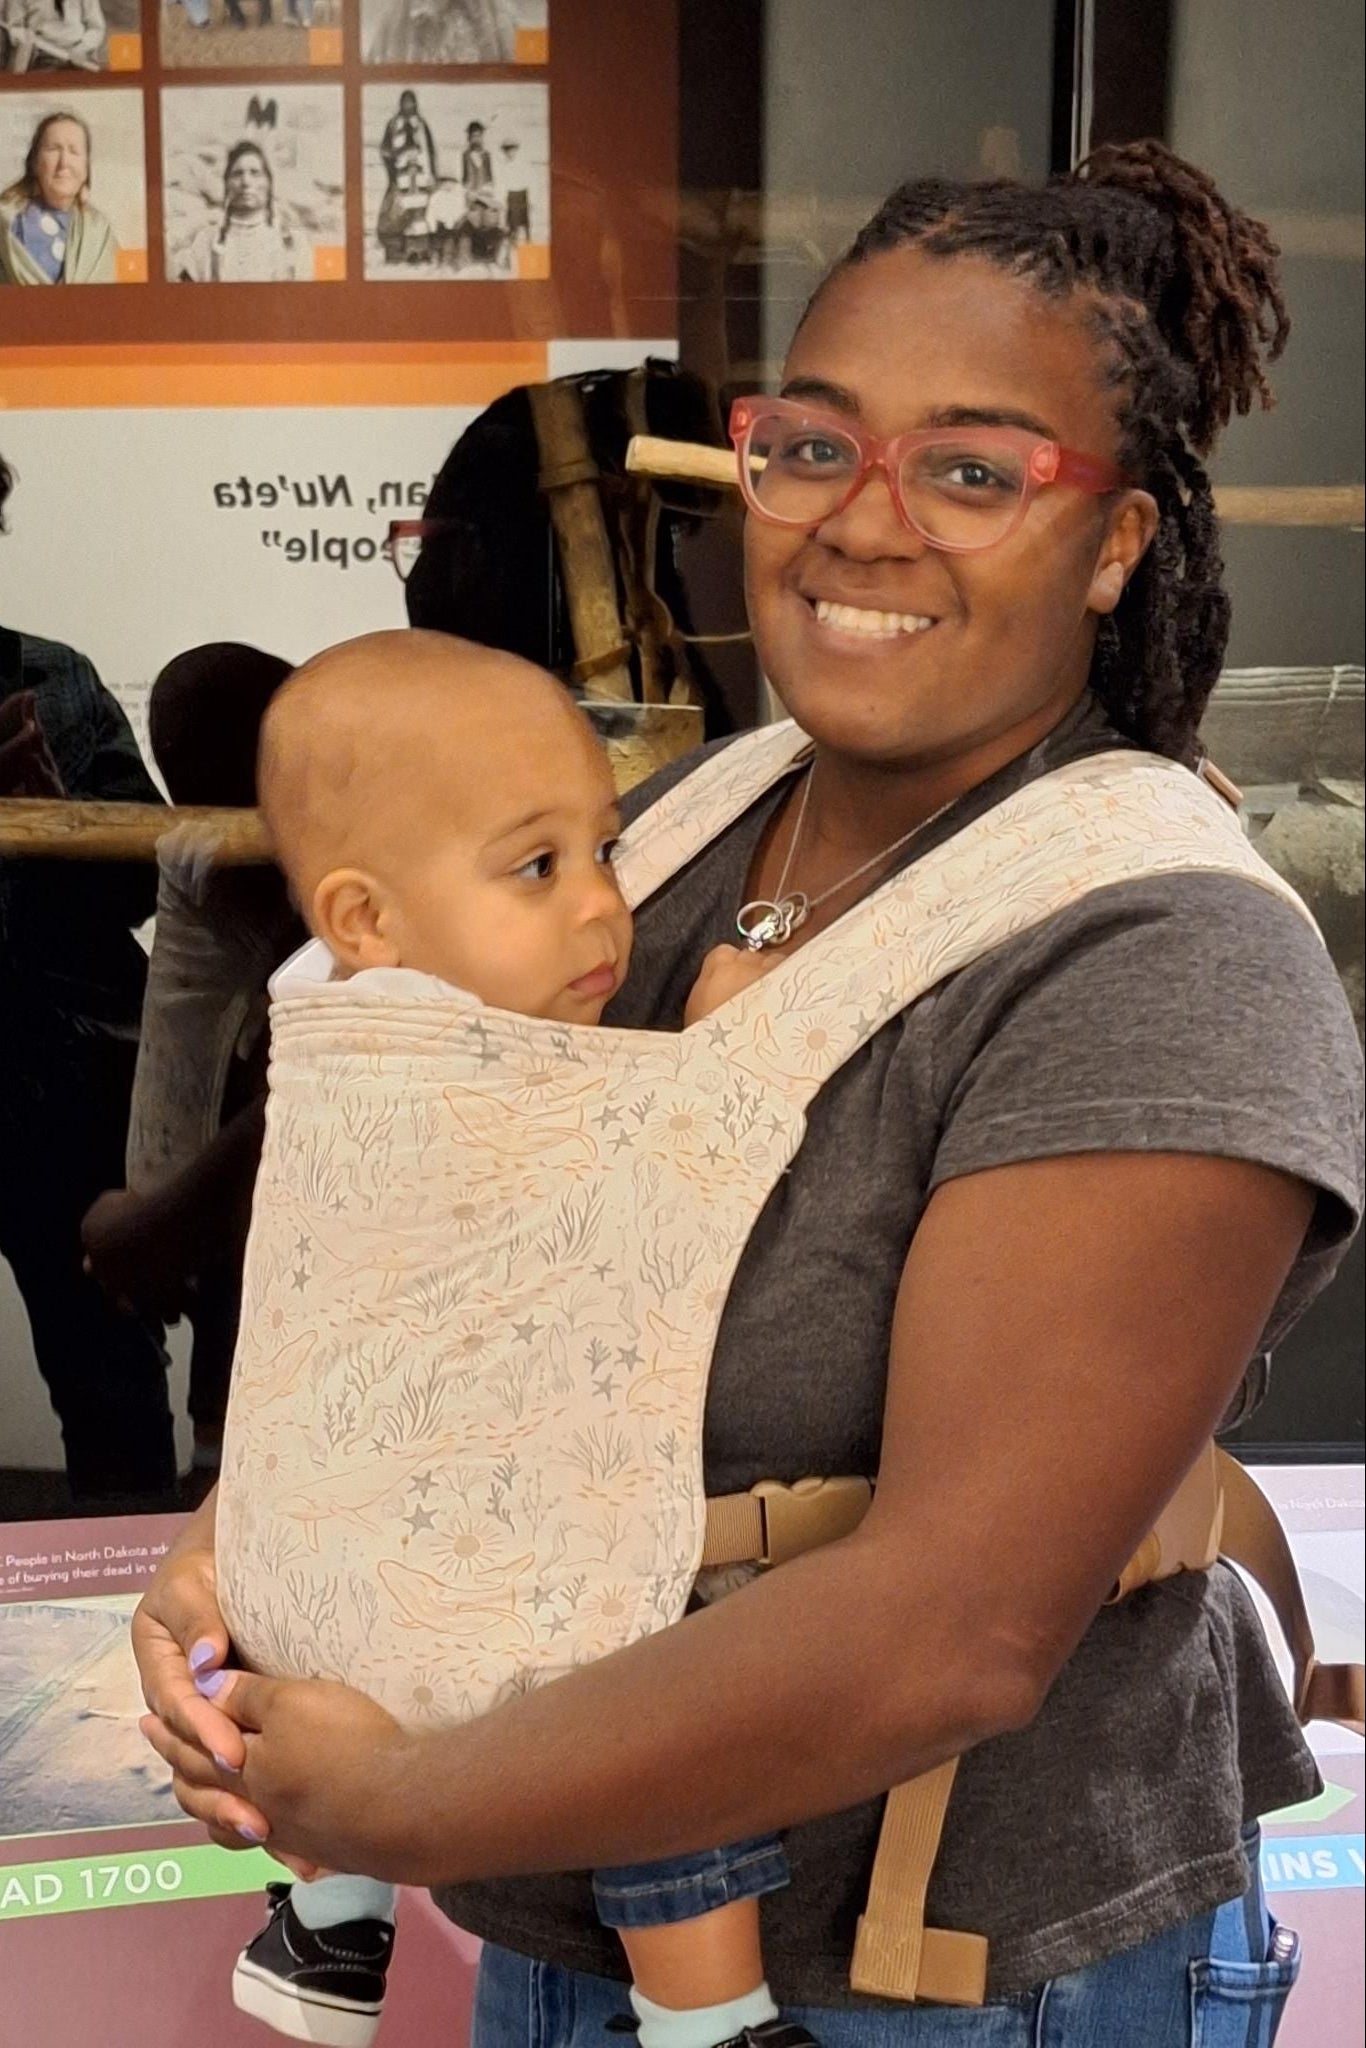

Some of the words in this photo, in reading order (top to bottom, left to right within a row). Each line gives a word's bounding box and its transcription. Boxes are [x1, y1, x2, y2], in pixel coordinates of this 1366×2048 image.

[6, 1554, 48, 1568] People
[51, 1553, 62, 1564] in
[65, 1548, 101, 1562] North
[104, 1546, 148, 1559] Dakota
[8, 1572, 20, 1585] of
[23, 1569, 69, 1584] burying
[72, 1566, 99, 1579] their
[103, 1563, 132, 1577] dead
[135, 1562, 146, 1574] in
[1262, 1849, 1339, 1881] INS
[0, 1874, 63, 1909] AD
[80, 1860, 182, 1899] 1700
